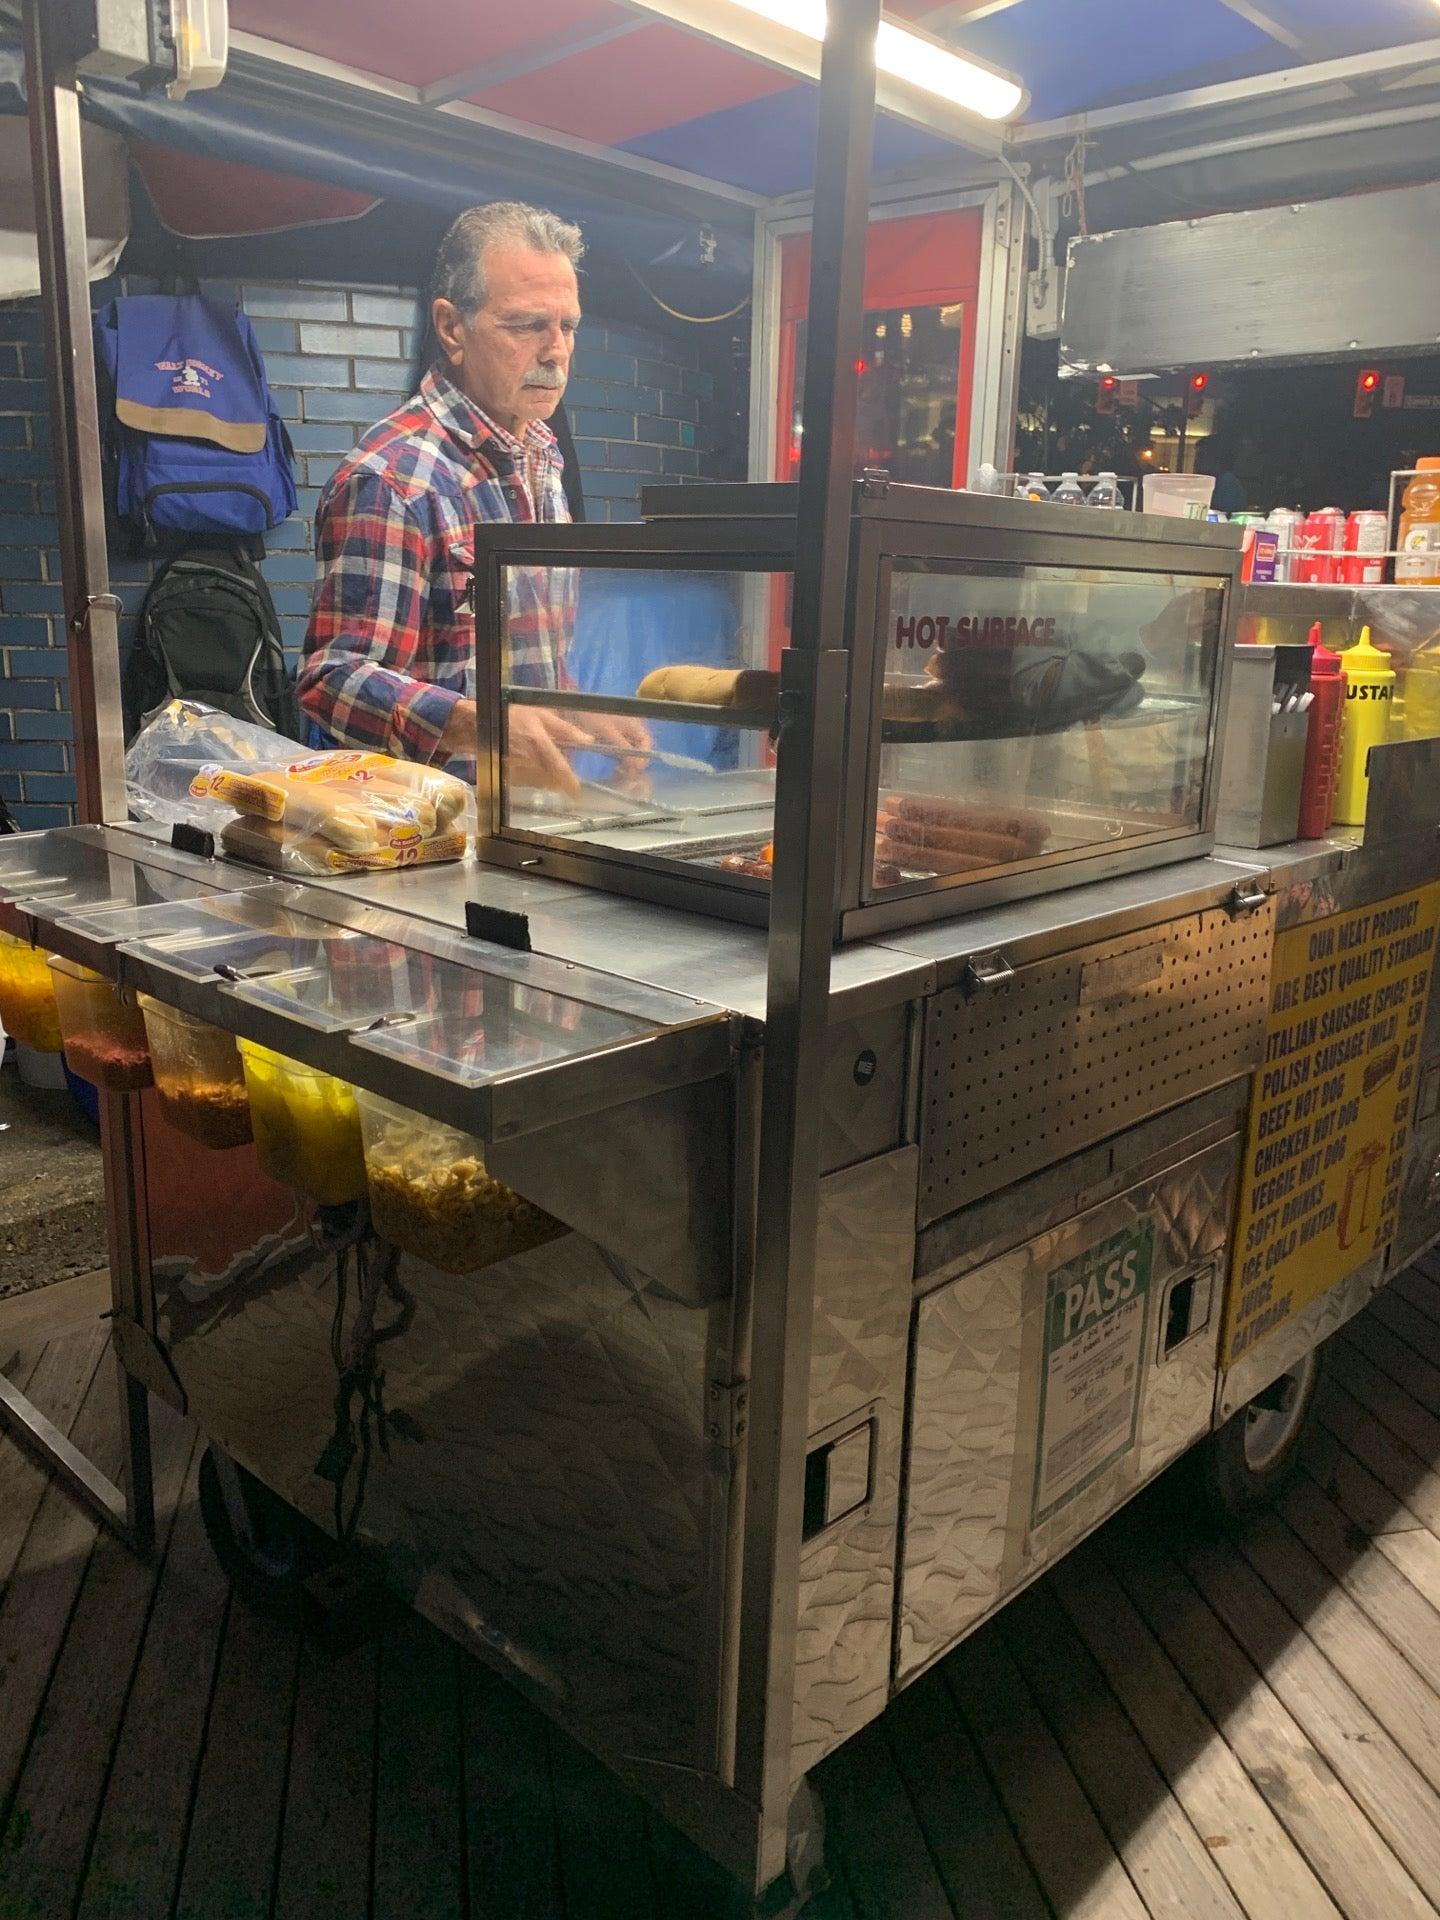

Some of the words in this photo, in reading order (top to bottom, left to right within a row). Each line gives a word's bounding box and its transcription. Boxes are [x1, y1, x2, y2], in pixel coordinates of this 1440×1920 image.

[896, 616, 949, 649] HOT
[957, 617, 1056, 647] SURFACE
[1346, 684, 1394, 700] USTA
[1309, 928, 1333, 961] OUR
[1339, 917, 1369, 950] MEAT
[1373, 901, 1418, 938] PRODUCT
[1273, 978, 1300, 1012] ARE
[1305, 965, 1335, 1001] BEST
[1339, 947, 1385, 990] QUALITY
[1266, 1017, 1316, 1063] ITALIAN
[1321, 993, 1371, 1039] SAUSAGE
[1263, 1055, 1309, 1101] POLISH
[1315, 1029, 1364, 1076] SAUSAGE
[1255, 1124, 1310, 1178] CHICKEN
[1314, 1111, 1335, 1143] HOT
[1339, 1098, 1359, 1128] DOG
[1259, 1100, 1291, 1140] BEEF
[1295, 1086, 1318, 1119] HOT
[1323, 1074, 1344, 1105] DOG
[1250, 1165, 1296, 1215] VEGGIE
[1325, 1136, 1346, 1168] DOG
[1247, 1209, 1279, 1252] SOFT
[1063, 1250, 1138, 1338] PASS
[1242, 1252, 1262, 1287] ICE
